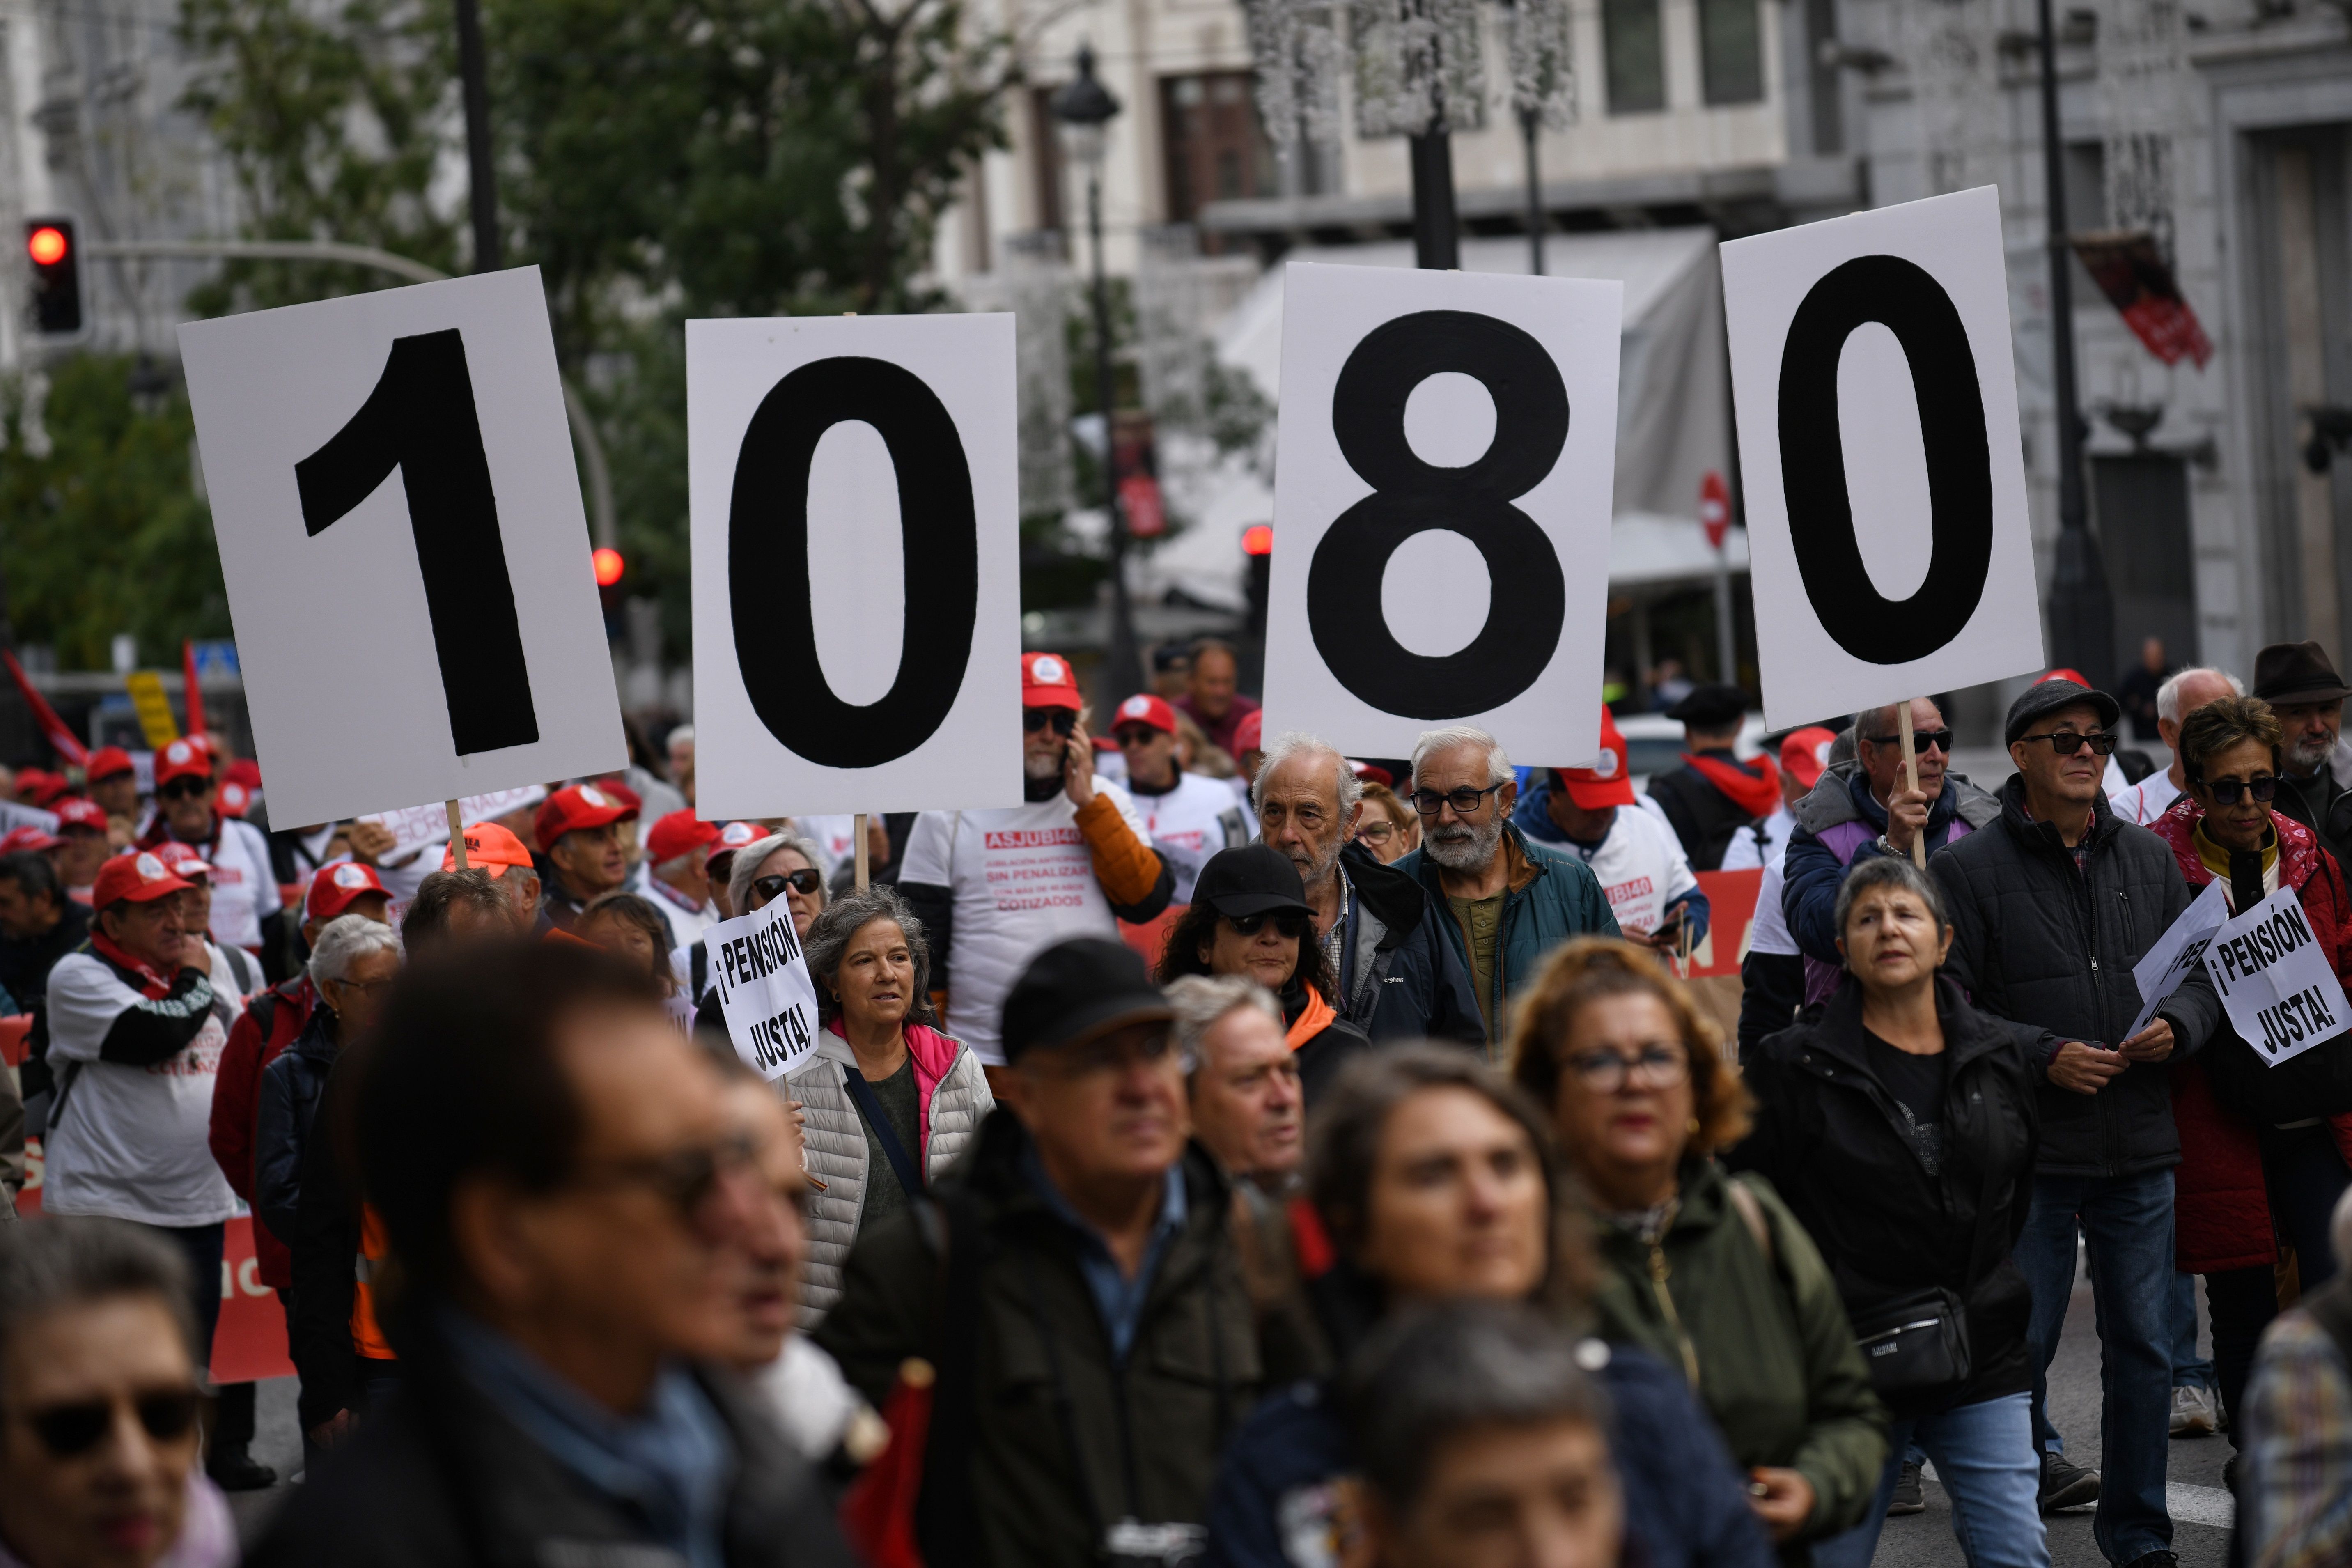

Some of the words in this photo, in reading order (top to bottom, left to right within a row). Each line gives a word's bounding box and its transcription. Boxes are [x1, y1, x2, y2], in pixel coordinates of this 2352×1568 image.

[294, 328, 539, 756] 1
[728, 356, 978, 768] 0
[1307, 310, 1570, 720] 8
[1778, 255, 1993, 665] 0
[987, 871, 1008, 882] SIN
[1013, 866, 1088, 880] PENALIZAR
[998, 895, 1083, 911] COTIZADOS
[750, 1003, 811, 1071] JUSTA!
[2257, 985, 2336, 1054] JUSTA!
